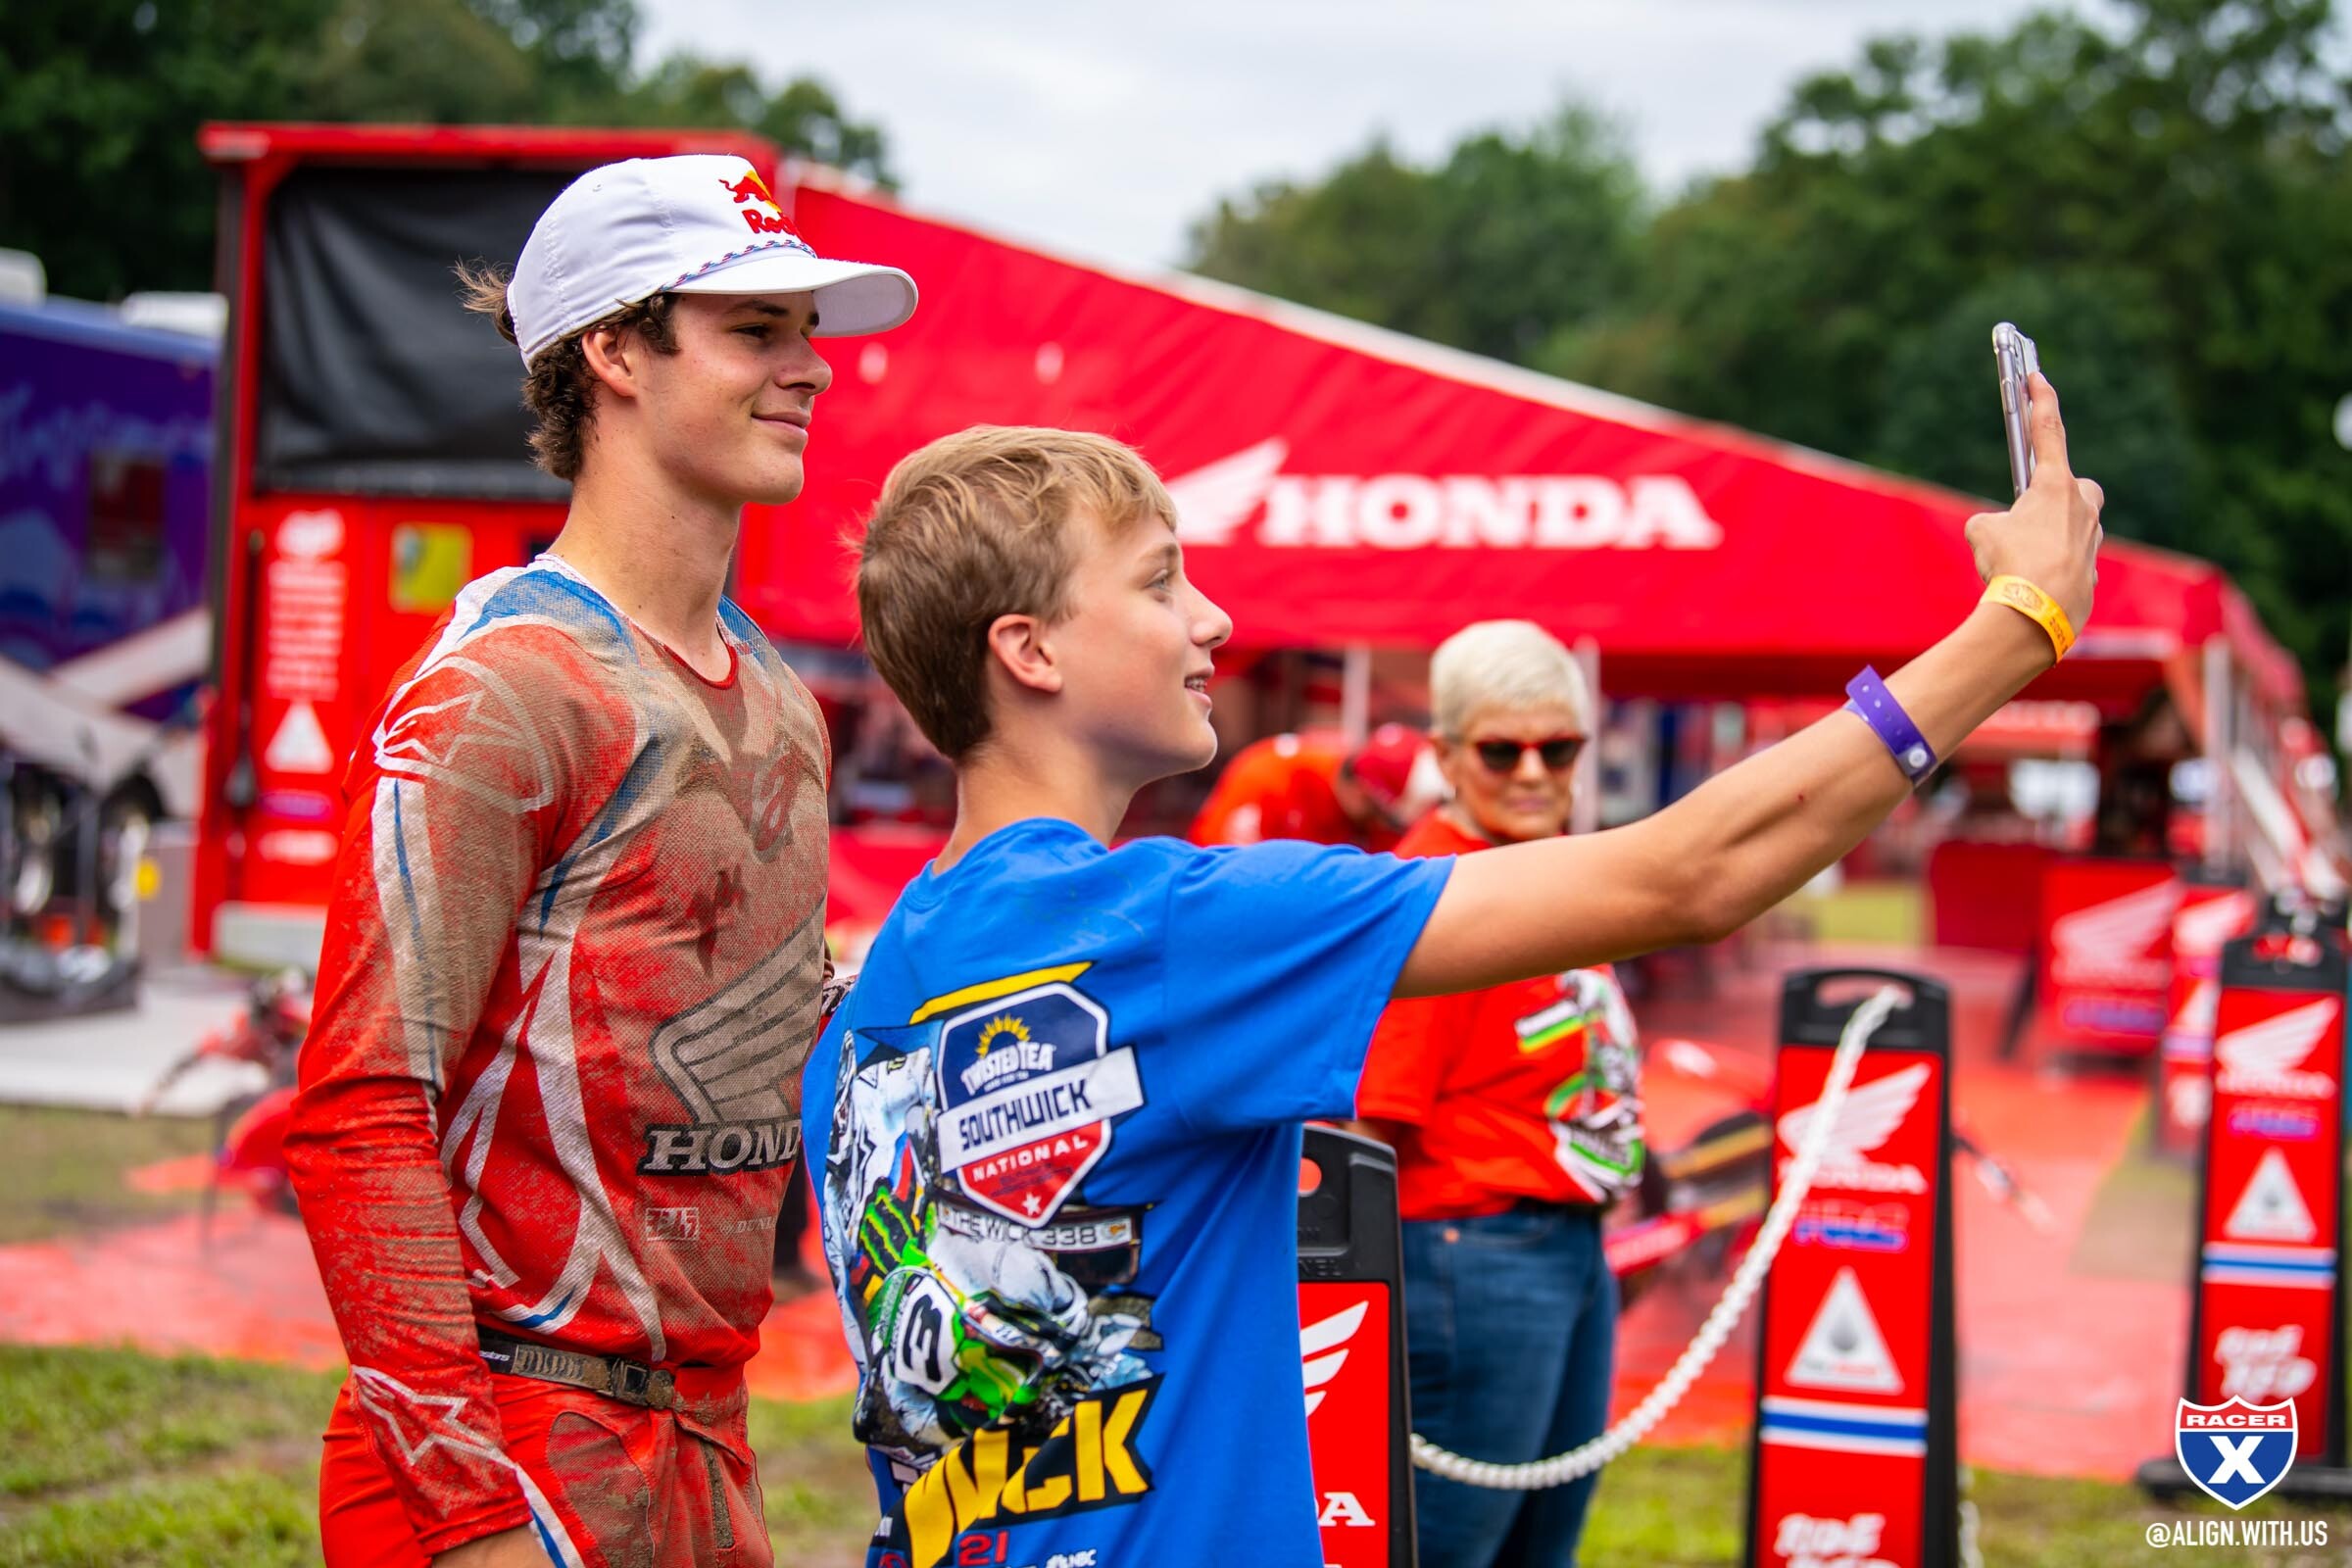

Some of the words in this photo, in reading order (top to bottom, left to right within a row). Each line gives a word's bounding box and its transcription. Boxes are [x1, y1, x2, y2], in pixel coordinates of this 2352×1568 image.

[1256, 473, 1725, 551] HONDA
[960, 1046, 1020, 1096] TWISTED
[1016, 1041, 1054, 1071] TEA
[959, 1079, 1092, 1152] SOUTHWICK
[973, 1135, 1089, 1182] NATIONAL
[1042, 1225, 1097, 1246] 338
[903, 1294, 943, 1383] 3
[957, 1531, 1008, 1567] 21
